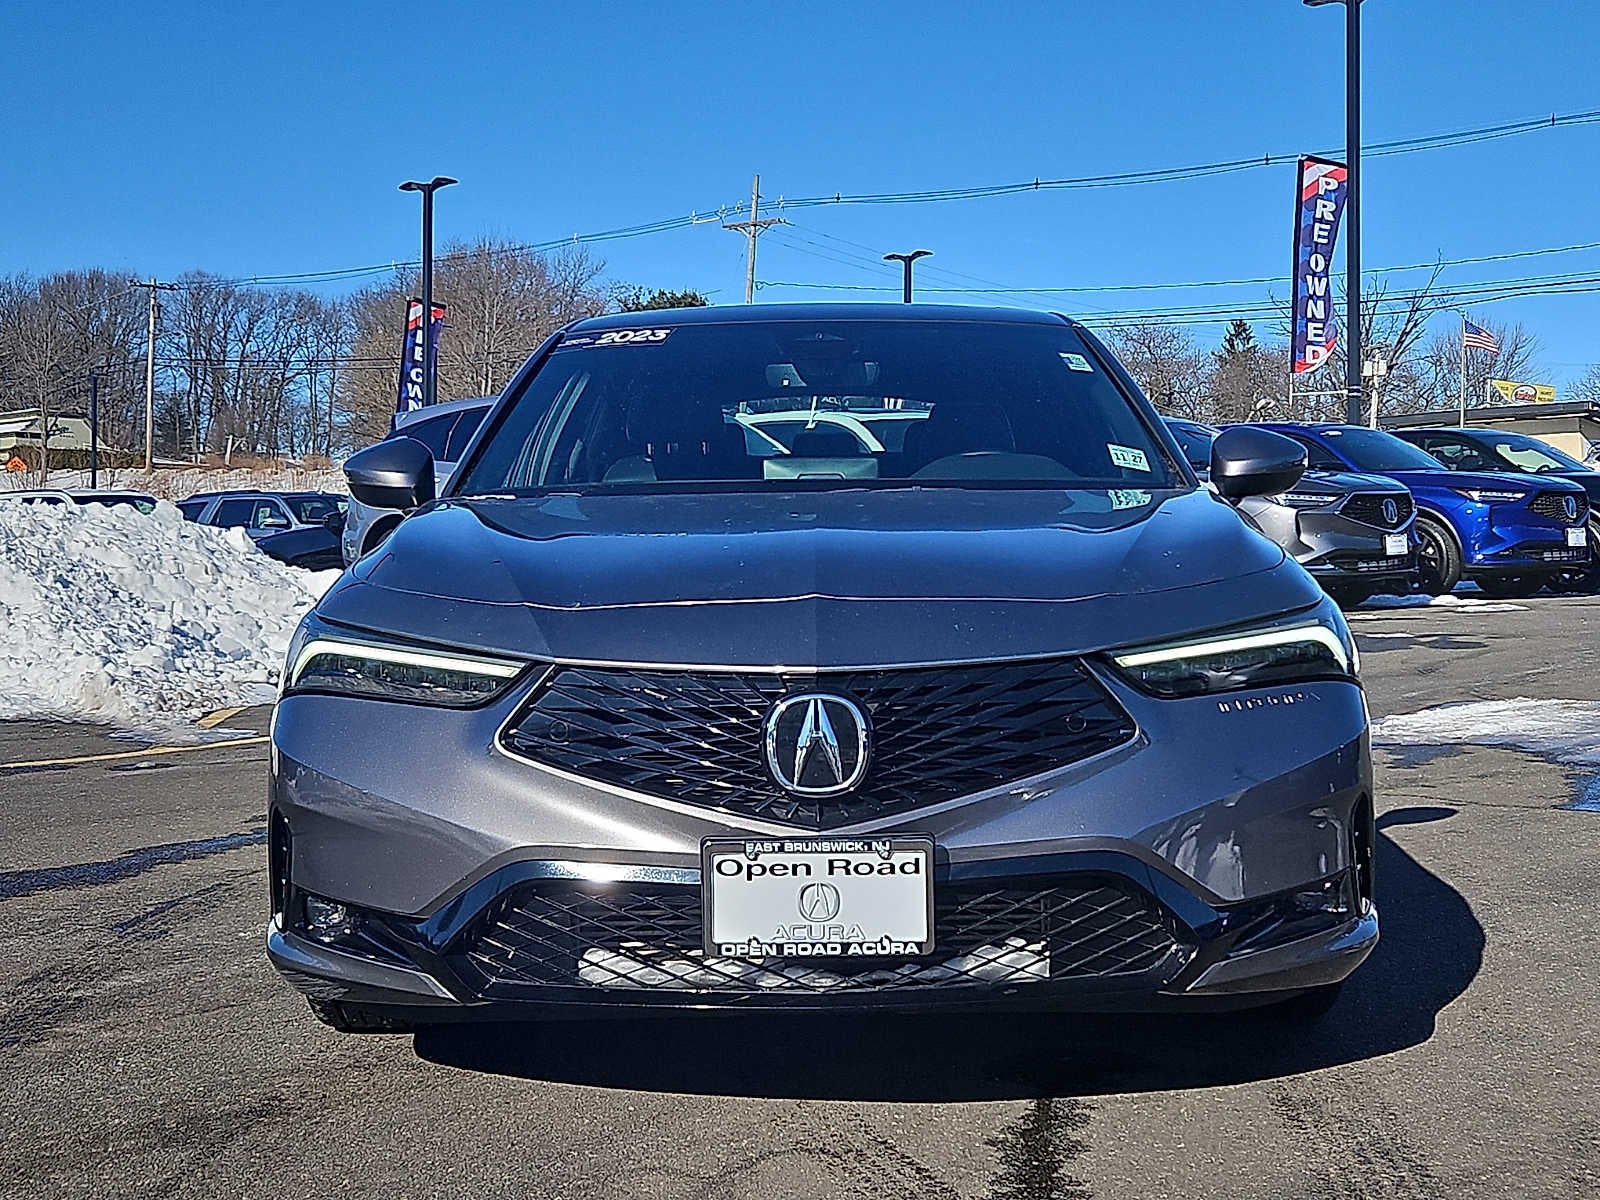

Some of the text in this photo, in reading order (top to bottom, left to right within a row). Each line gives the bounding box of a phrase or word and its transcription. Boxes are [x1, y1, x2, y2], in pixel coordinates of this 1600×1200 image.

[1306, 176, 1338, 366] PRE OWNED
[595, 330, 671, 345] 2023
[1131, 454, 1143, 464] 27
[745, 841, 891, 853] EAST BRUNSWICK, NJ
[715, 857, 921, 881] Open Road
[773, 923, 866, 941] ACURA
[720, 942, 920, 956] OPEN ROAD ACURA
